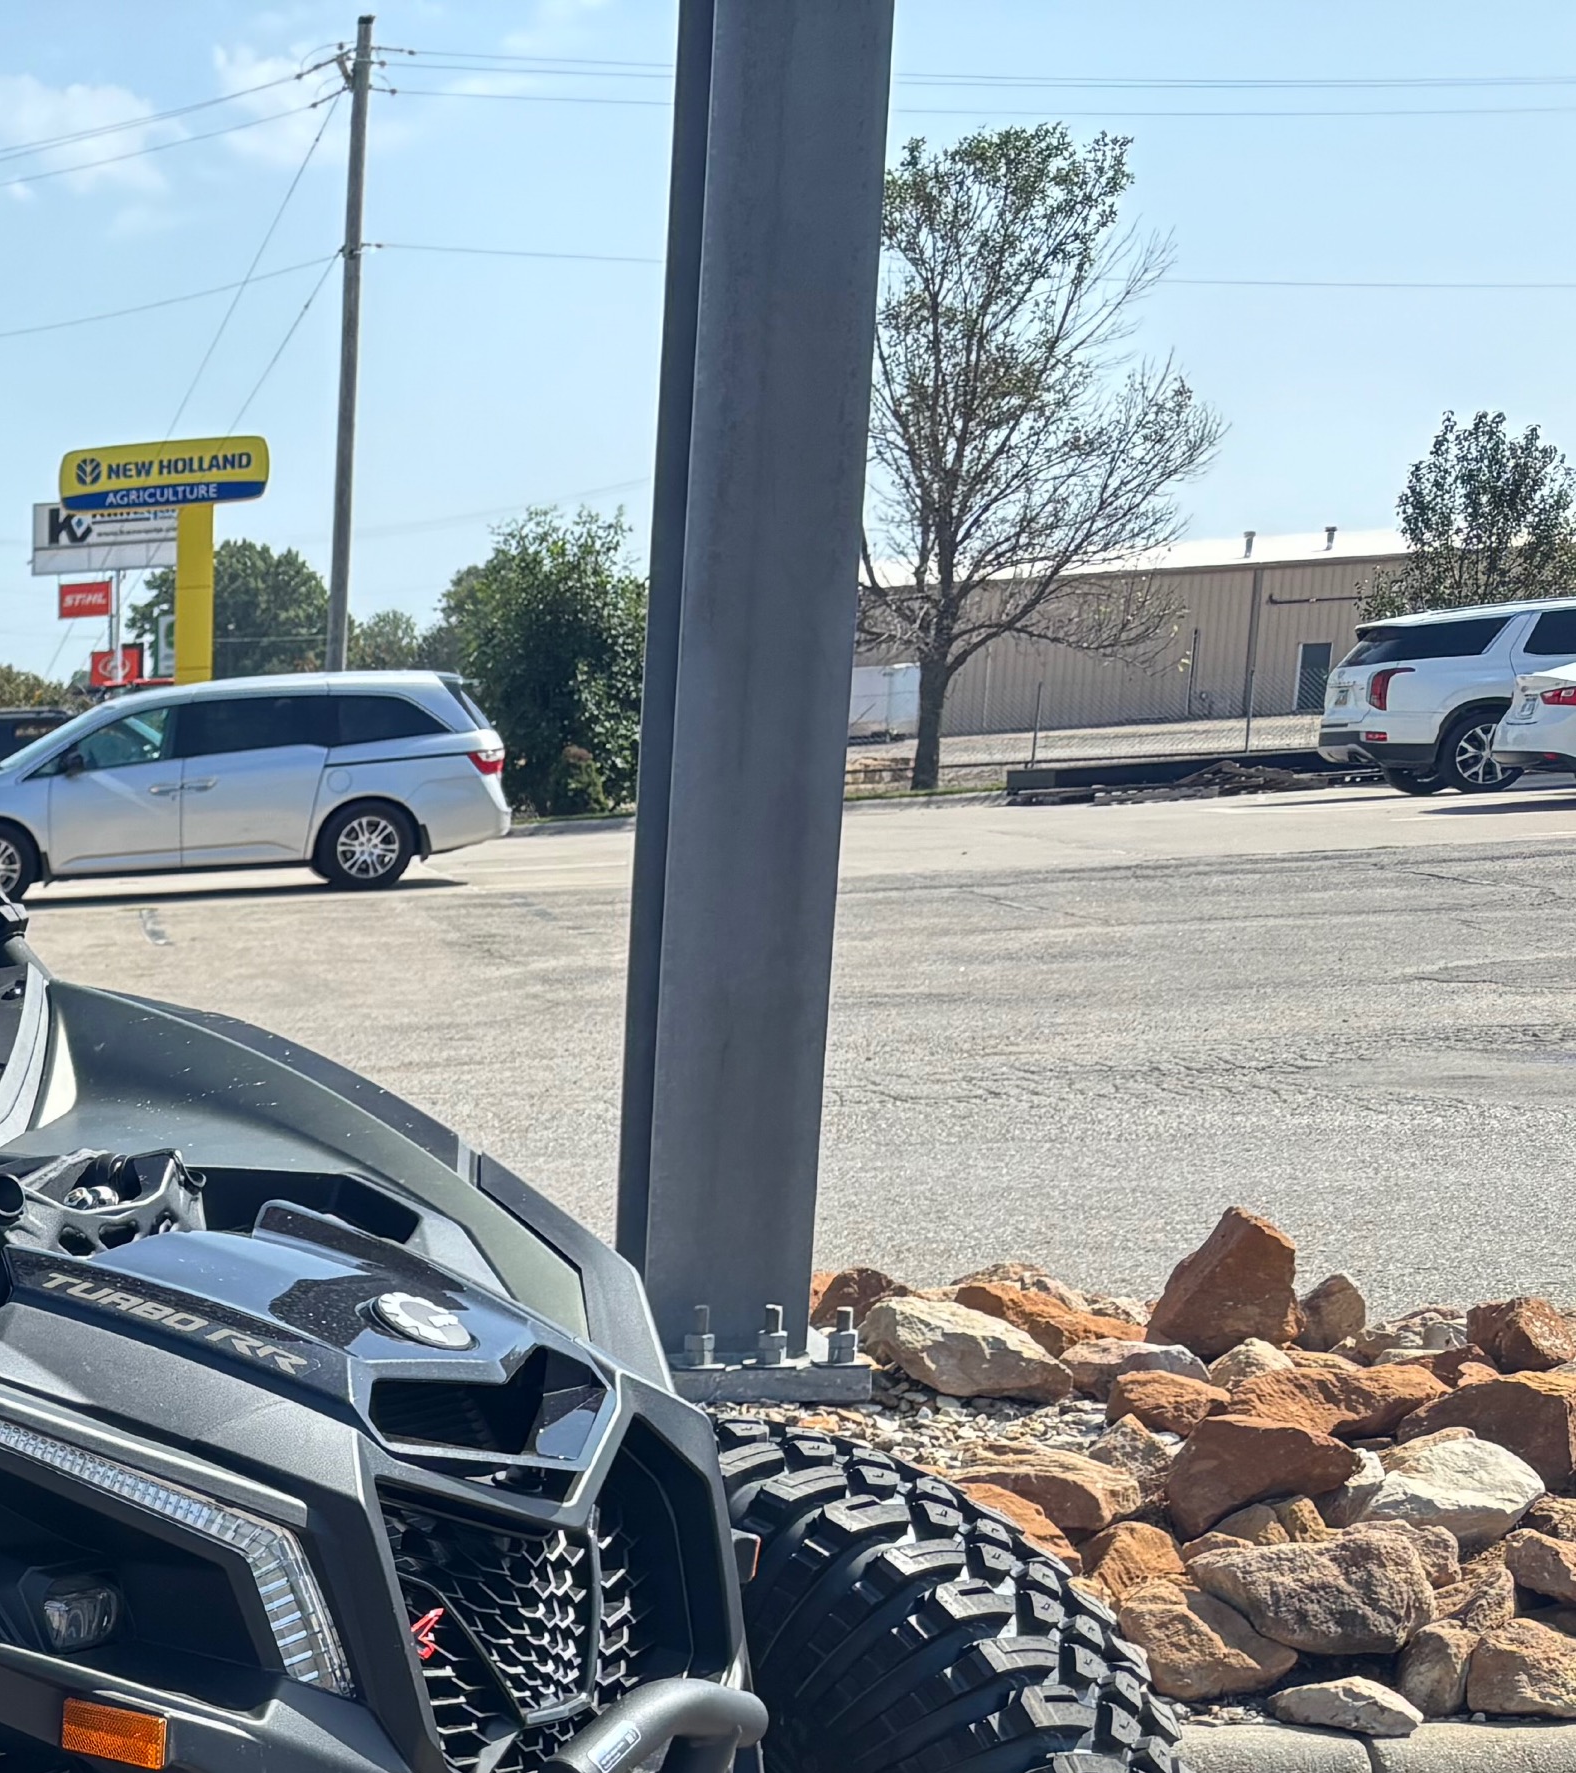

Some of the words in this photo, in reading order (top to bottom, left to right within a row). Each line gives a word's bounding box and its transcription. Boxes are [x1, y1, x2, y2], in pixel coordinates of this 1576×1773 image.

[106, 459, 155, 481] NEW
[158, 451, 252, 477] HOLLAND
[105, 482, 218, 507] AGRICULTURE
[62, 592, 108, 608] STIHL
[41, 1271, 209, 1333] TURBO
[204, 1329, 310, 1375] RR
